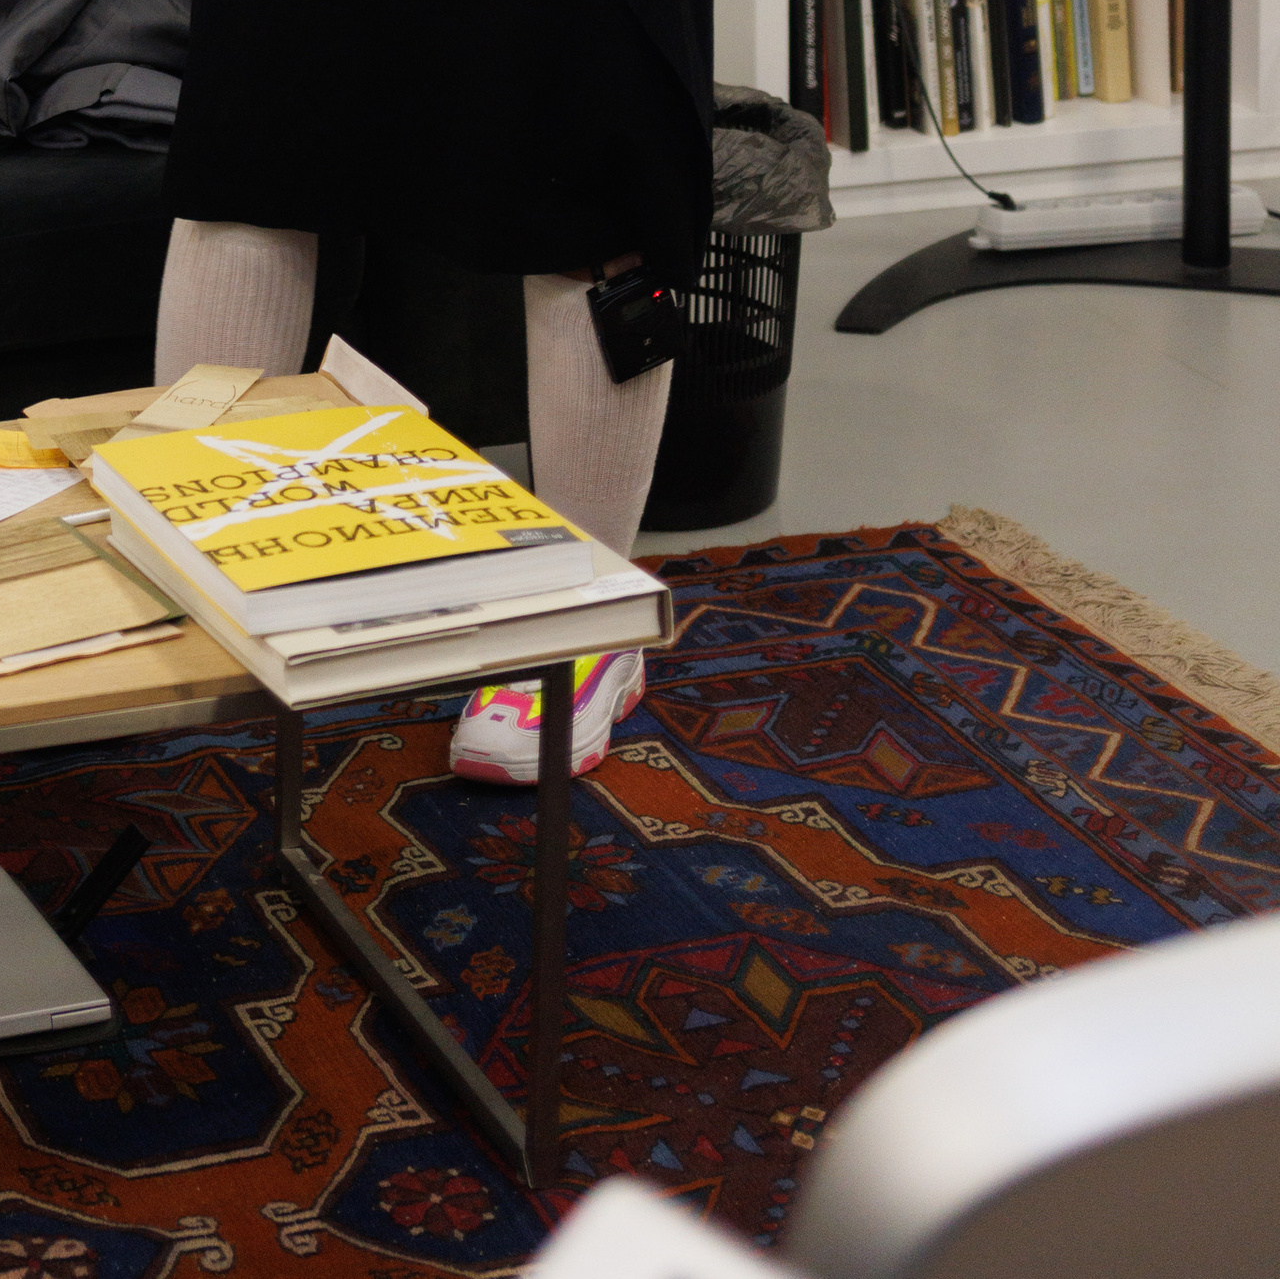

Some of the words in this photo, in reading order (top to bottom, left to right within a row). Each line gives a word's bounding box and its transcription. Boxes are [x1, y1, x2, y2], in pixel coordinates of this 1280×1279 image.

[138, 446, 460, 503] CHAMPIONS
[340, 482, 516, 515] МИРА
[160, 478, 370, 524] WORLD
[202, 504, 551, 568] ЧЕМПИОНЫ
